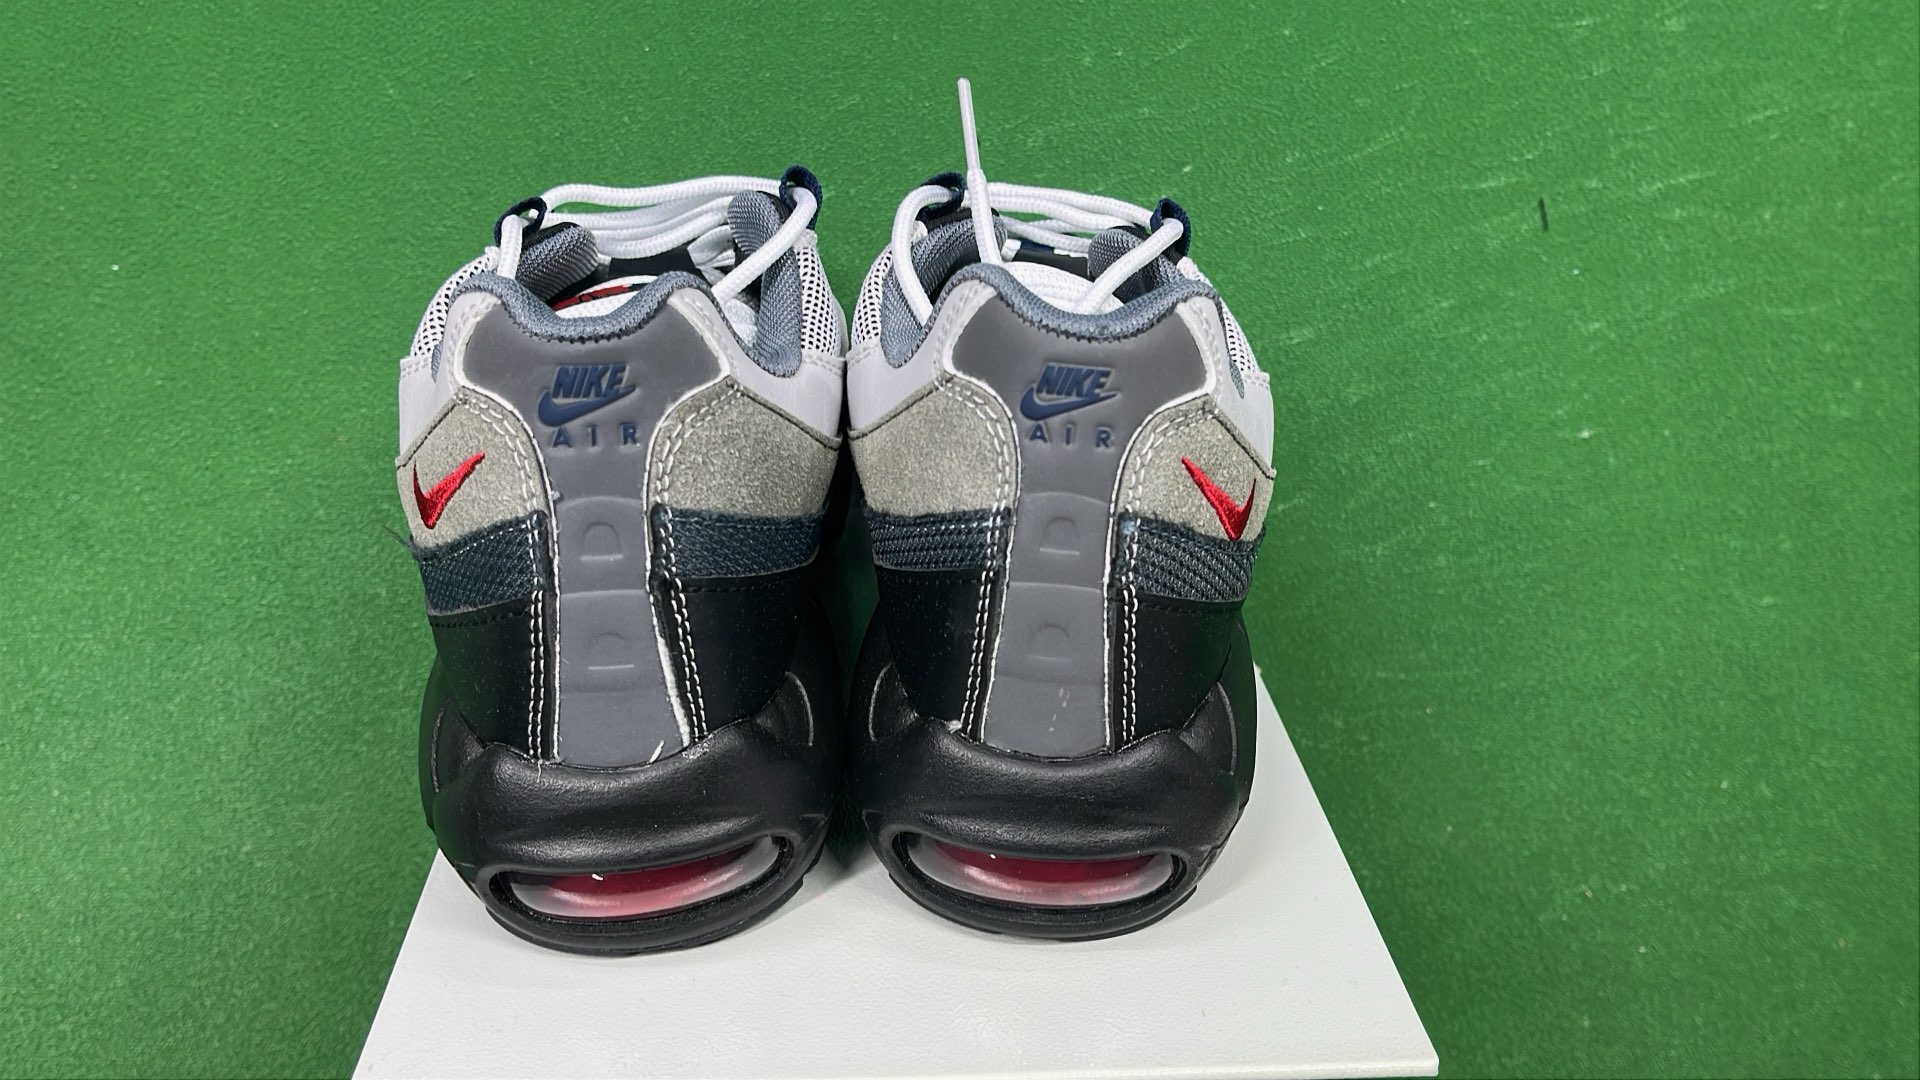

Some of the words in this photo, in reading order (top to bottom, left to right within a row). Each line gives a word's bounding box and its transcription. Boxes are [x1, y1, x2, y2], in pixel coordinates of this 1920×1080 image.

[552, 364, 627, 398] NIKE
[1036, 365, 1111, 397] NIKE
[552, 424, 638, 448] AIR
[1030, 423, 1111, 448] AIR
